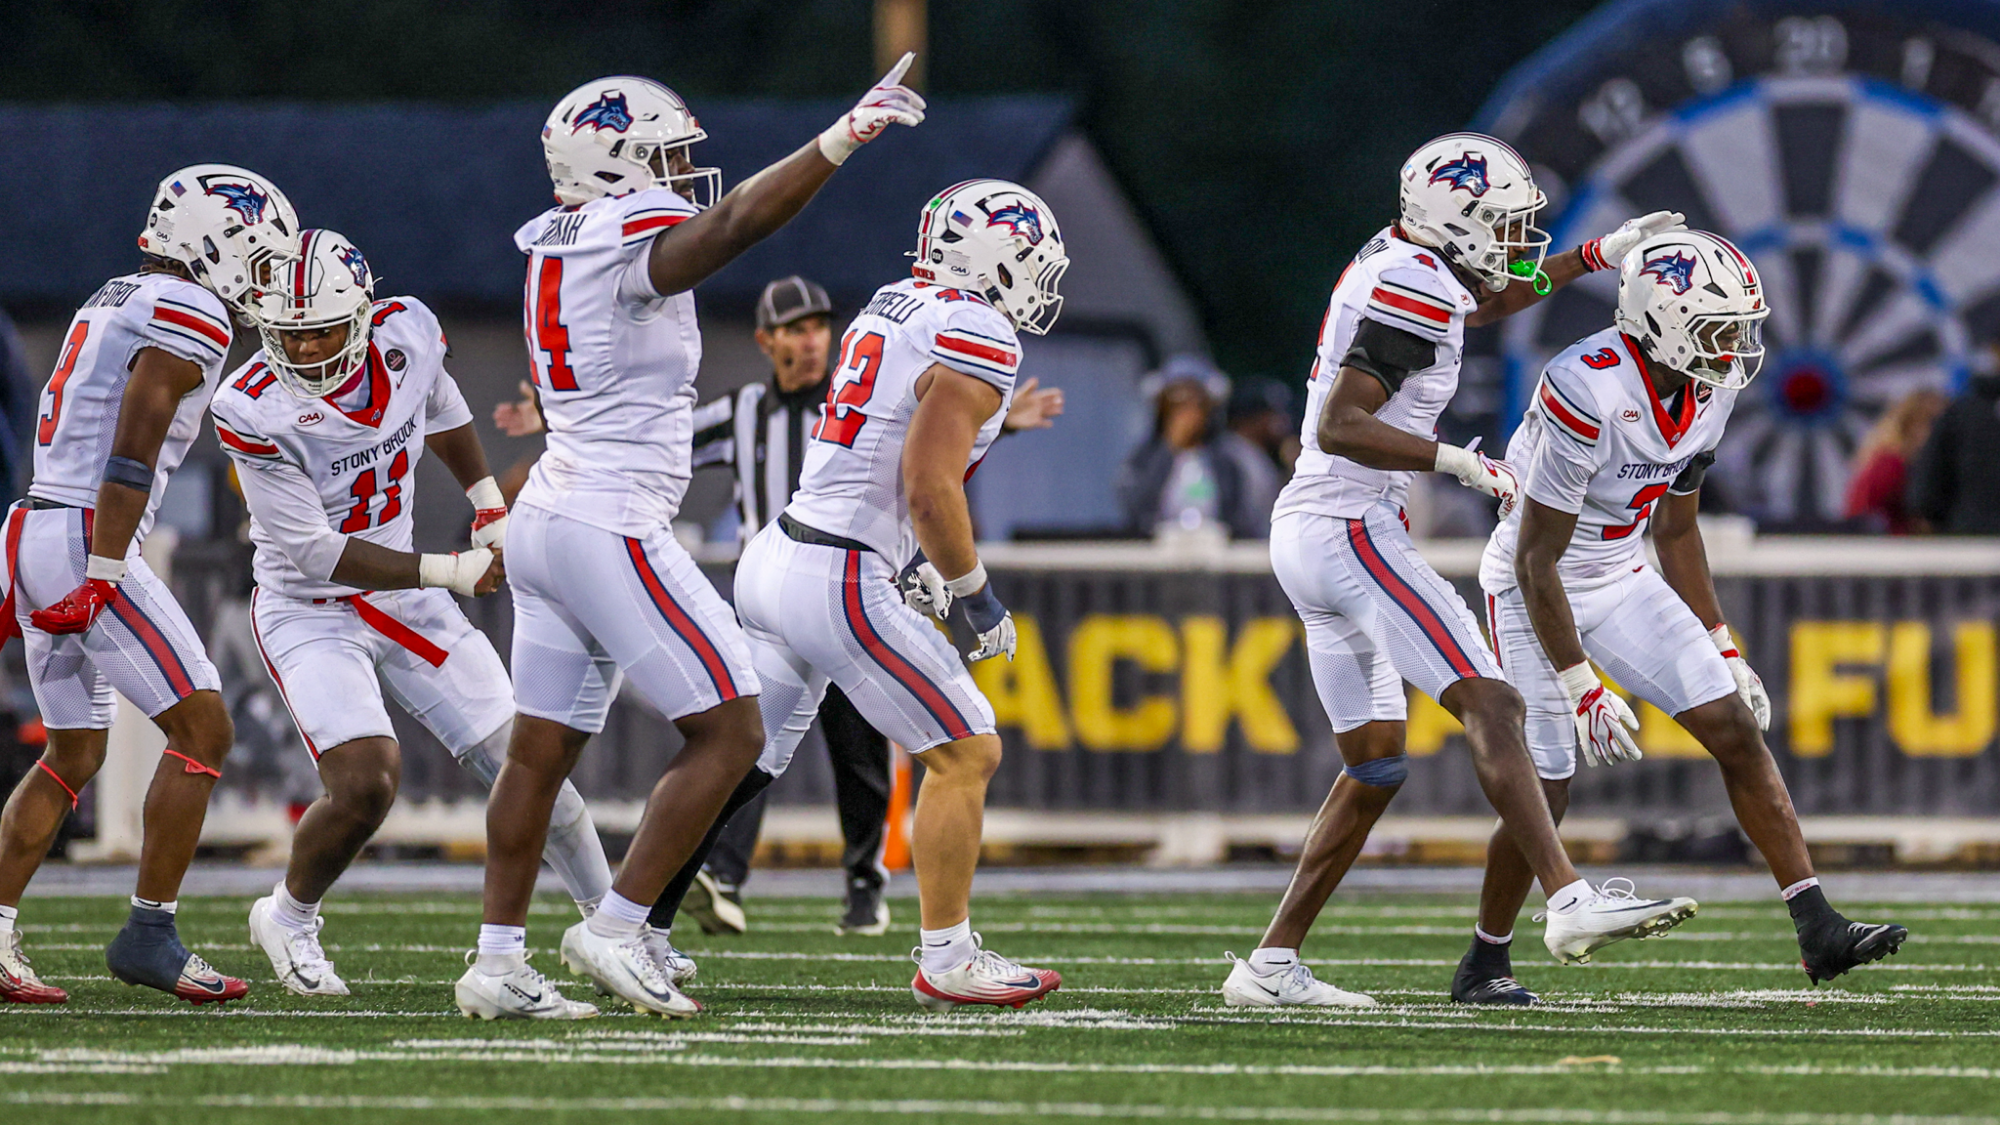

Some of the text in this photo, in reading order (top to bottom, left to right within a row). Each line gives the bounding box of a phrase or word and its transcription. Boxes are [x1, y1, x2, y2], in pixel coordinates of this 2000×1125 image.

[1580, 347, 1621, 370] 3
[38, 320, 90, 447] 9
[232, 361, 278, 401] 11
[298, 412, 320, 424] CAA
[1623, 410, 1638, 418] CAA
[331, 412, 417, 477] STONY BROOK
[339, 445, 409, 535] 11
[1617, 463, 1664, 480] STONY
[936, 612, 1300, 756] ACK
